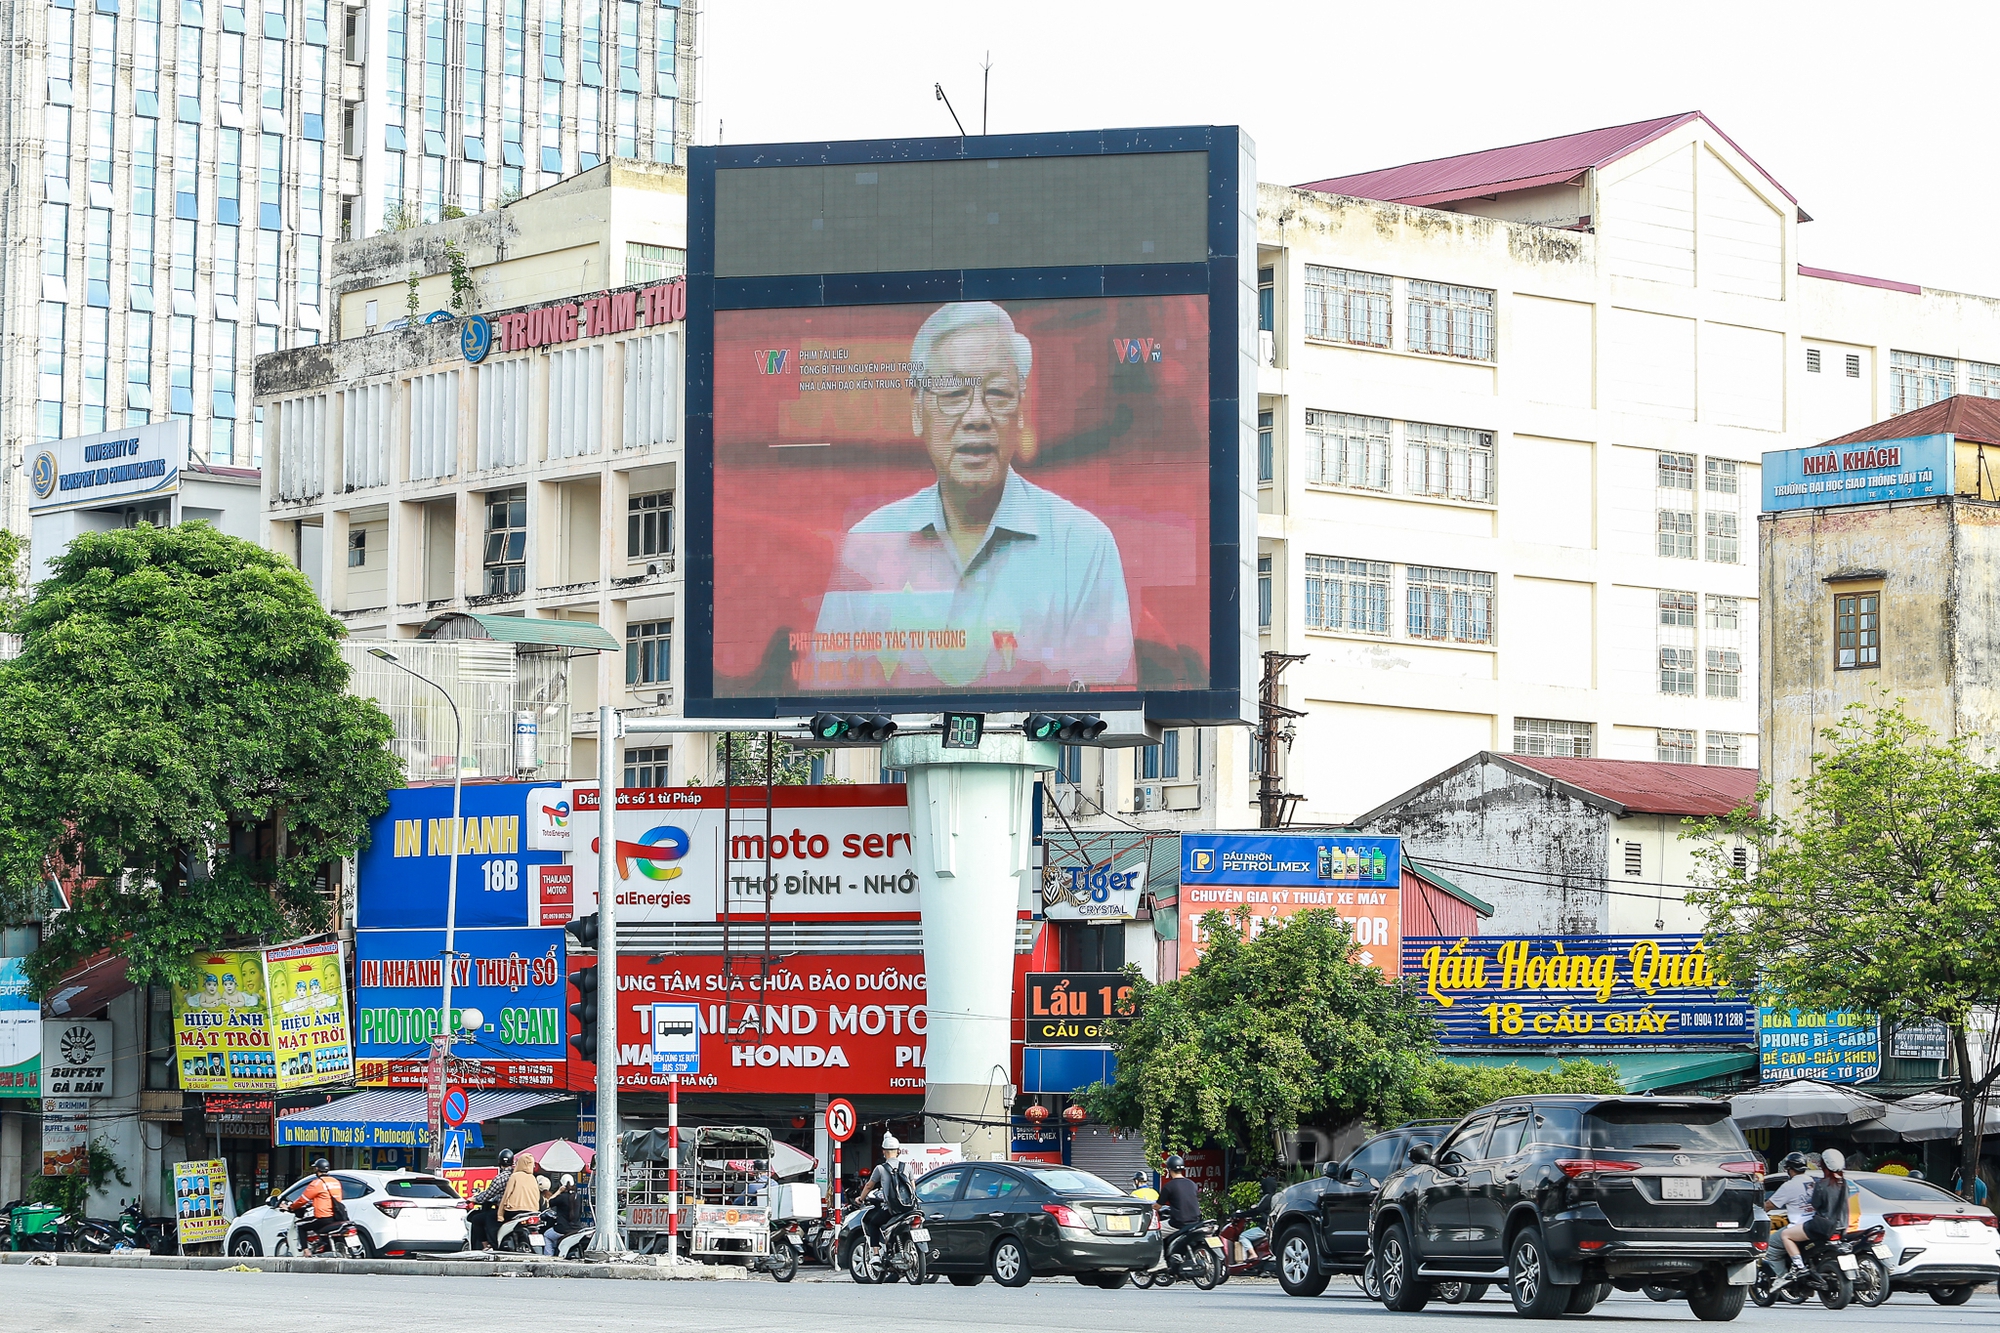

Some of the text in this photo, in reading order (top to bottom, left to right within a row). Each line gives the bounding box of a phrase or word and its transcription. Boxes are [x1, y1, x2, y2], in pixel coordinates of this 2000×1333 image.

[499, 290, 636, 352] TRUNG TÂM
[799, 347, 849, 360] PHIM TÀI LIỆU
[880, 359, 896, 372] PHÚ
[897, 361, 924, 373] TRỌNG
[799, 379, 815, 390] NHÀ
[838, 380, 855, 393] ĐẠO
[85, 437, 140, 463] UNIVERSITY OF
[1803, 446, 1901, 475] NHÀ KHÁCH
[59, 458, 166, 491] TRANSPORT AND COMMUNICATIONS
[1826, 480, 1844, 494] HỌC
[1845, 478, 1866, 490] GIAO
[1867, 475, 1897, 487] THÔNG
[1898, 473, 1916, 486] VẬN
[815, 628, 906, 651] TRÁCH CÔNG TÁC
[578, 792, 702, 806] Dầu số 1 từ Pháp
[394, 815, 519, 857] IN NHANH
[542, 829, 570, 838] TotalEnergies
[732, 828, 829, 860] moto
[1223, 850, 1245, 862] DẦU
[481, 859, 519, 892] 18B
[1223, 860, 1311, 873] PETROLIMEX
[542, 875, 572, 884] THAILAND
[731, 868, 924, 902] THỢ ĐỈNH NHỚ
[1066, 863, 1140, 903] Tiger
[546, 886, 568, 895] MOTOR
[592, 890, 691, 908] TalEnergies
[1190, 885, 1387, 906] CHUYÊN GIA KỸ THUẬT XE MÁY
[1078, 905, 1128, 916] CRYSTAL
[361, 960, 380, 987] IN
[382, 960, 443, 987] NHANH
[475, 952, 529, 992] THUẬT
[532, 944, 559, 987] SỐ
[1421, 936, 1489, 1007] Lẩu
[1497, 940, 1620, 1003] Hoàng
[660, 967, 927, 991] TÂM SỬA CHỮA BẢO DƯỠNG
[1033, 979, 1136, 1016] Lẩu 18
[183, 1008, 264, 1029] HIỆU ẢNH
[281, 1010, 341, 1034] HIỆU ẢNH
[500, 1007, 559, 1046] SCAN
[632, 1004, 818, 1035] TILAND
[1481, 1003, 1744, 1035] 18 CẦU GIẤY ĐT: 0904 12 1288
[1042, 1020, 1079, 1037] CẦU
[180, 1028, 271, 1049] MẶT TRỜI
[278, 1028, 345, 1051] MẶT TRỜI
[1762, 1029, 1876, 1048] PHONG BÌ CARD
[679, 1053, 686, 1062] XE
[731, 1045, 927, 1068] HONDA PI
[1762, 1048, 1876, 1065] ĐỀ CAN GIẤY KHEN
[50, 1067, 106, 1078] BUFFET
[360, 1060, 383, 1083] 18B
[662, 1063, 689, 1072] BUS STOP
[1762, 1065, 1829, 1080] CATALOGUE
[1838, 1063, 1853, 1078] TỜ
[52, 1079, 71, 1093] GÀ
[73, 1079, 104, 1093] RÁN
[233, 1082, 249, 1090] CHỤP
[250, 1079, 264, 1089] ẢNH
[627, 1072, 648, 1085] CẦU
[681, 1072, 697, 1085] HÀ
[699, 1074, 718, 1088] NỘI
[58, 1101, 88, 1110] RIRIMIMI
[45, 1124, 88, 1132] BUFFET 169K
[225, 1124, 270, 1135] FOOD & TEA
[285, 1126, 293, 1141] In
[294, 1126, 319, 1142] Nhanh
[320, 1126, 330, 1144] Kỹ
[332, 1126, 352, 1146] Thuật
[354, 1124, 365, 1143] Số
[374, 1127, 417, 1145] Photocopy,
[578, 1121, 595, 1133] PHOTO
[1184, 1165, 1221, 1178] TAY GA
[182, 1220, 204, 1229] ẢNH
[632, 1208, 653, 1225] 0975
